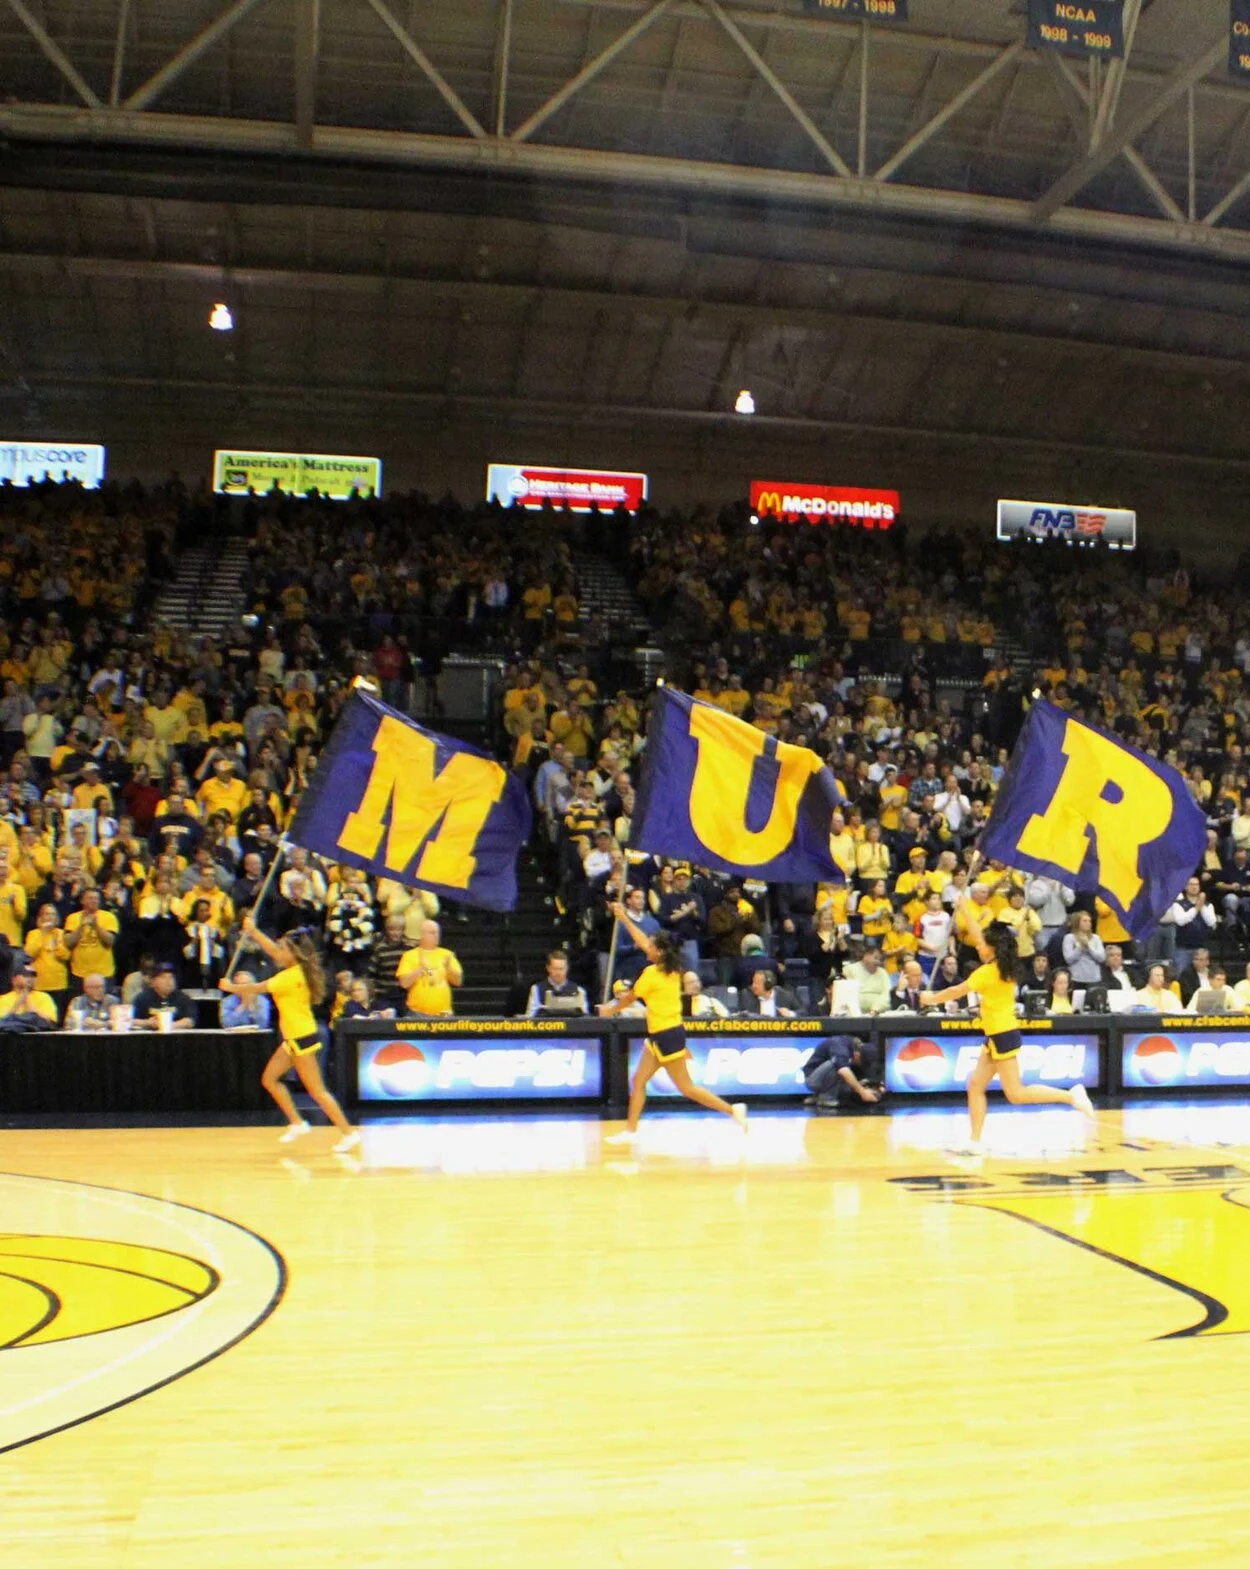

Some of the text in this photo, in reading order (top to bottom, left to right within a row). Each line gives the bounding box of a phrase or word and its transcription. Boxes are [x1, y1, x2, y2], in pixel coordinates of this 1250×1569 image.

[1056, 3, 1096, 23] NCAA
[1040, 24, 1068, 42] 1998
[303, 459, 369, 473] Mattress
[782, 495, 895, 519] McDonald's
[689, 703, 823, 866] U
[337, 714, 507, 889] M
[1017, 718, 1173, 912] R
[395, 1020, 567, 1032] www.yourlifeyourbank.com
[683, 1018, 822, 1031] ww.cfsbcenter.com
[435, 1050, 586, 1088] PEPSI
[703, 1048, 815, 1085] PEP
[954, 1045, 1086, 1081] PPSI
